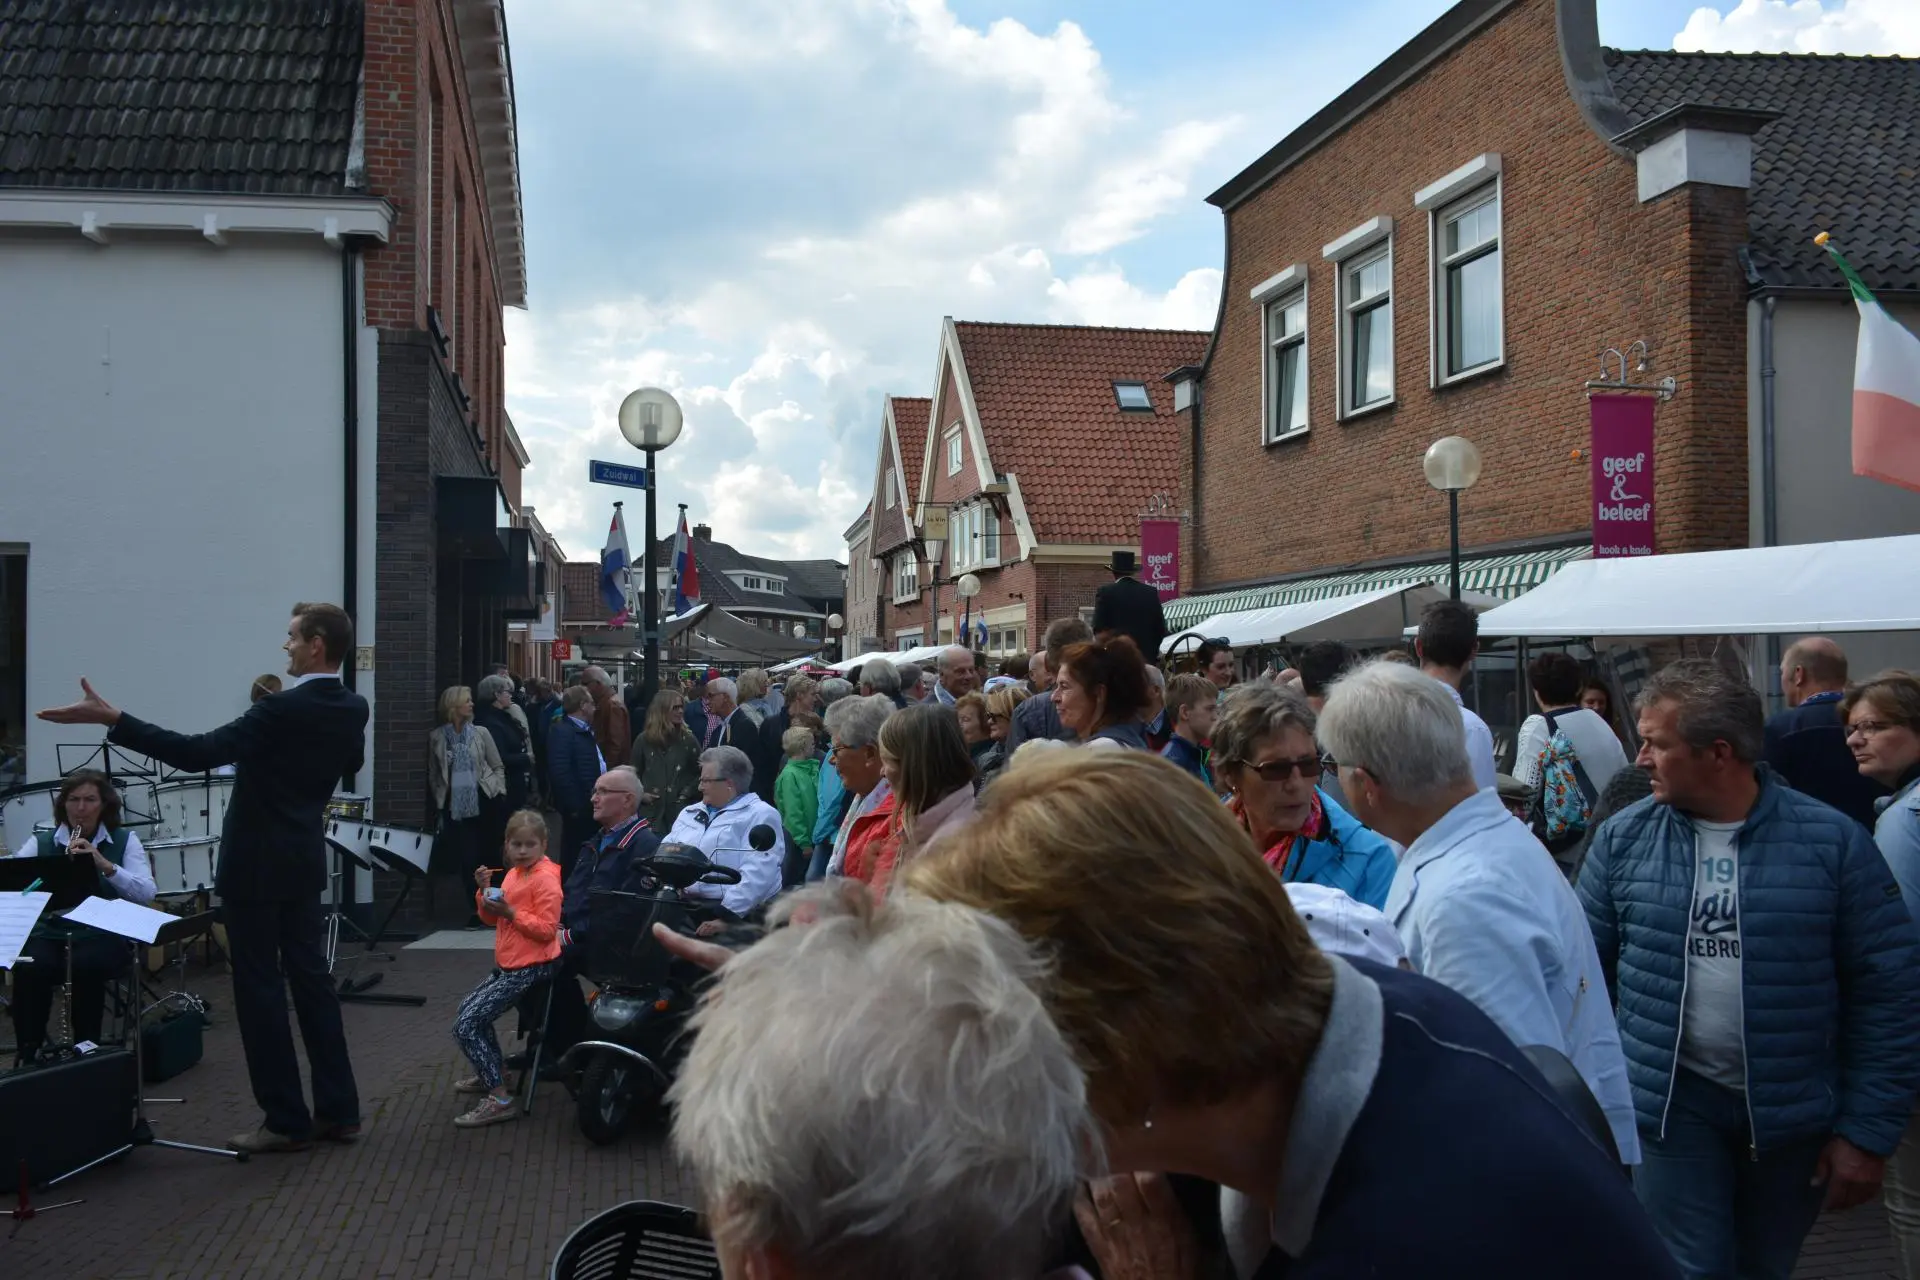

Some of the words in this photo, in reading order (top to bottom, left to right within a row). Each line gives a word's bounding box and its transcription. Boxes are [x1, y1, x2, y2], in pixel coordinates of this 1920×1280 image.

[1602, 452, 1645, 478] geef
[602, 468, 637, 482] Zuidwal
[1610, 474, 1643, 501] &
[1599, 502, 1651, 521] beleef
[1147, 552, 1172, 566] geef
[1152, 565, 1170, 579] &
[1701, 857, 1735, 883] 19
